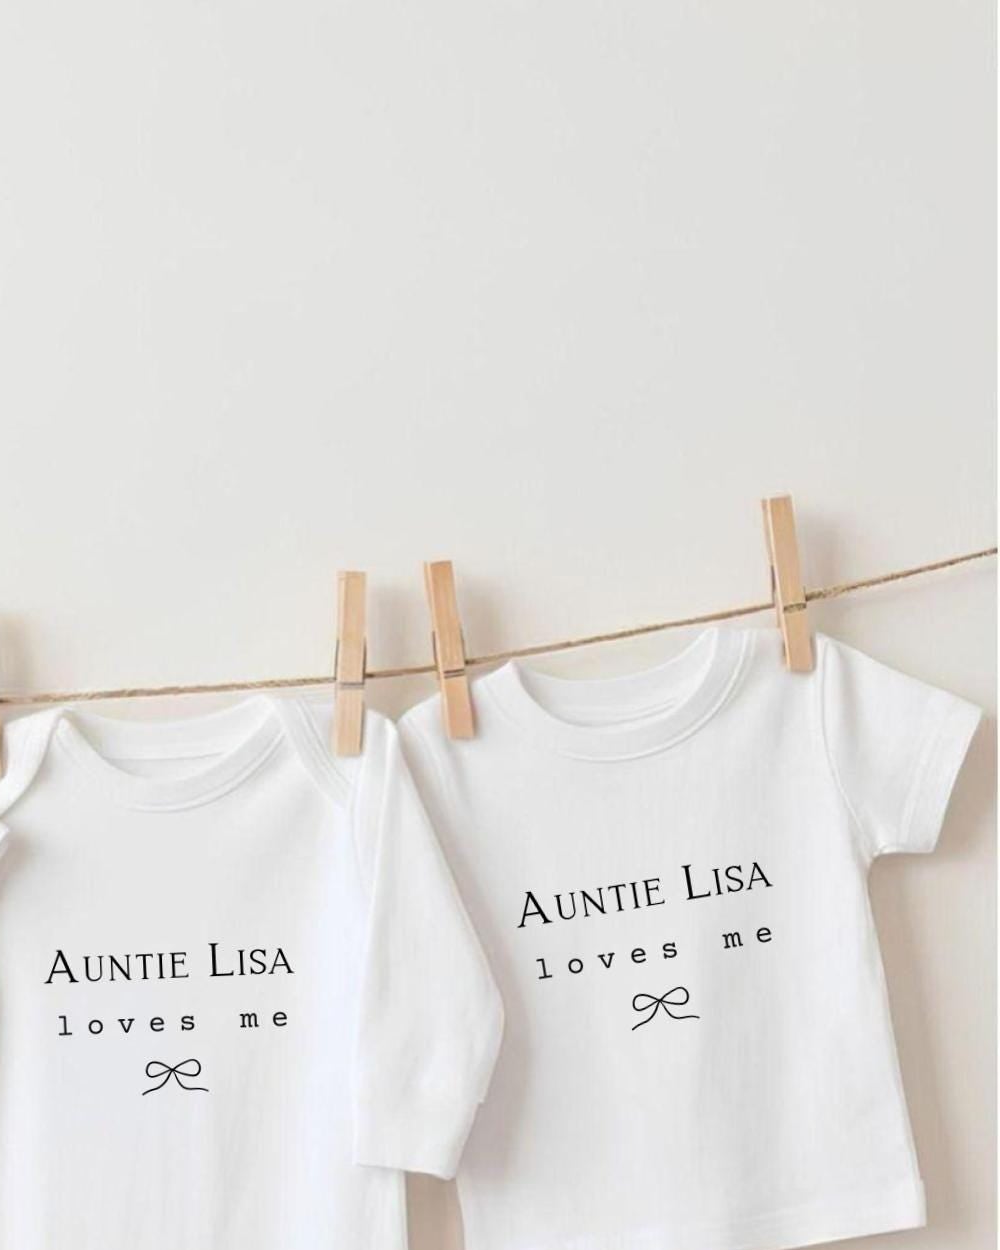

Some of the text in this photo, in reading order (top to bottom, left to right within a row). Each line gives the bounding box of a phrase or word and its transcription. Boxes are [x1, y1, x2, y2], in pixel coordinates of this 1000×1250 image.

[517, 862, 773, 929] AUNTIE LISA
[45, 942, 295, 985] AUNTIE LISA
[535, 927, 772, 980] loves me
[58, 1011, 288, 1037] loves me
